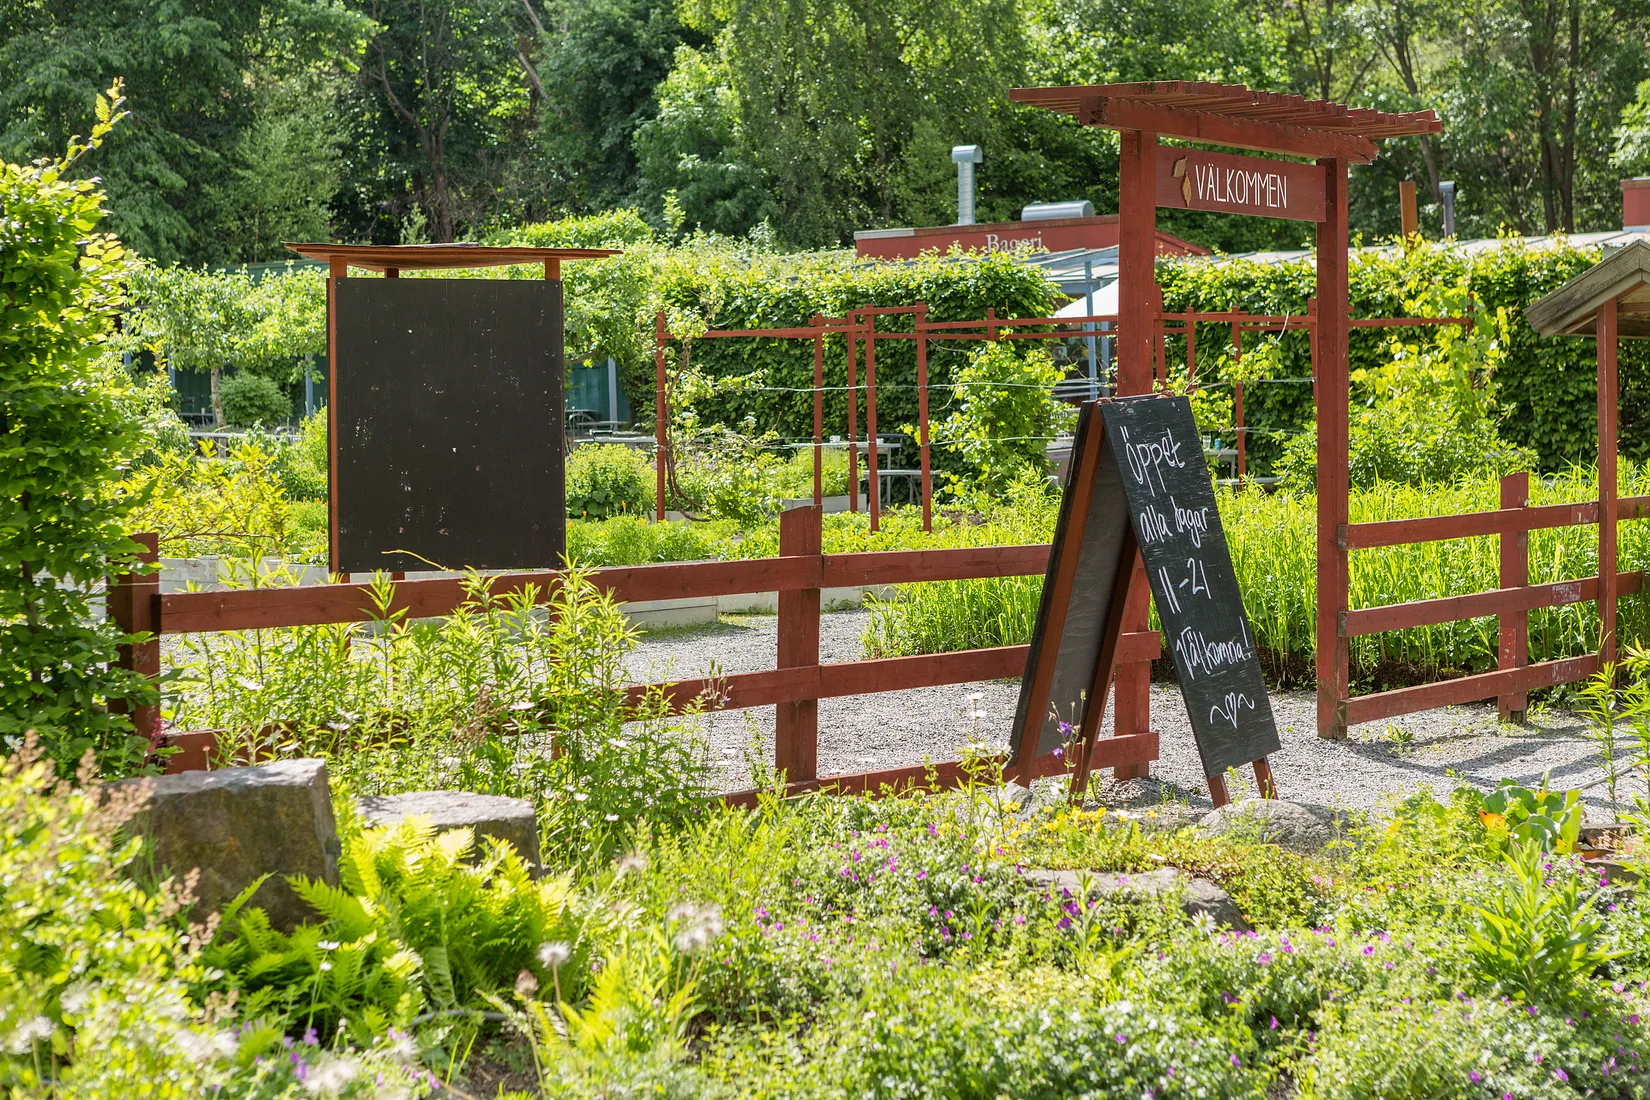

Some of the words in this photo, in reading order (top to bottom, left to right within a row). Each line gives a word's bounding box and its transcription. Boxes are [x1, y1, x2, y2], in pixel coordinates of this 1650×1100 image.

[1195, 163, 1287, 208] VÄLKOMMEN
[1119, 425, 1186, 497] Öppet
[1140, 504, 1173, 543] alla
[1169, 495, 1209, 549] dagar
[1158, 557, 1212, 615] 11-21
[1176, 616, 1253, 681] Välkomna!
